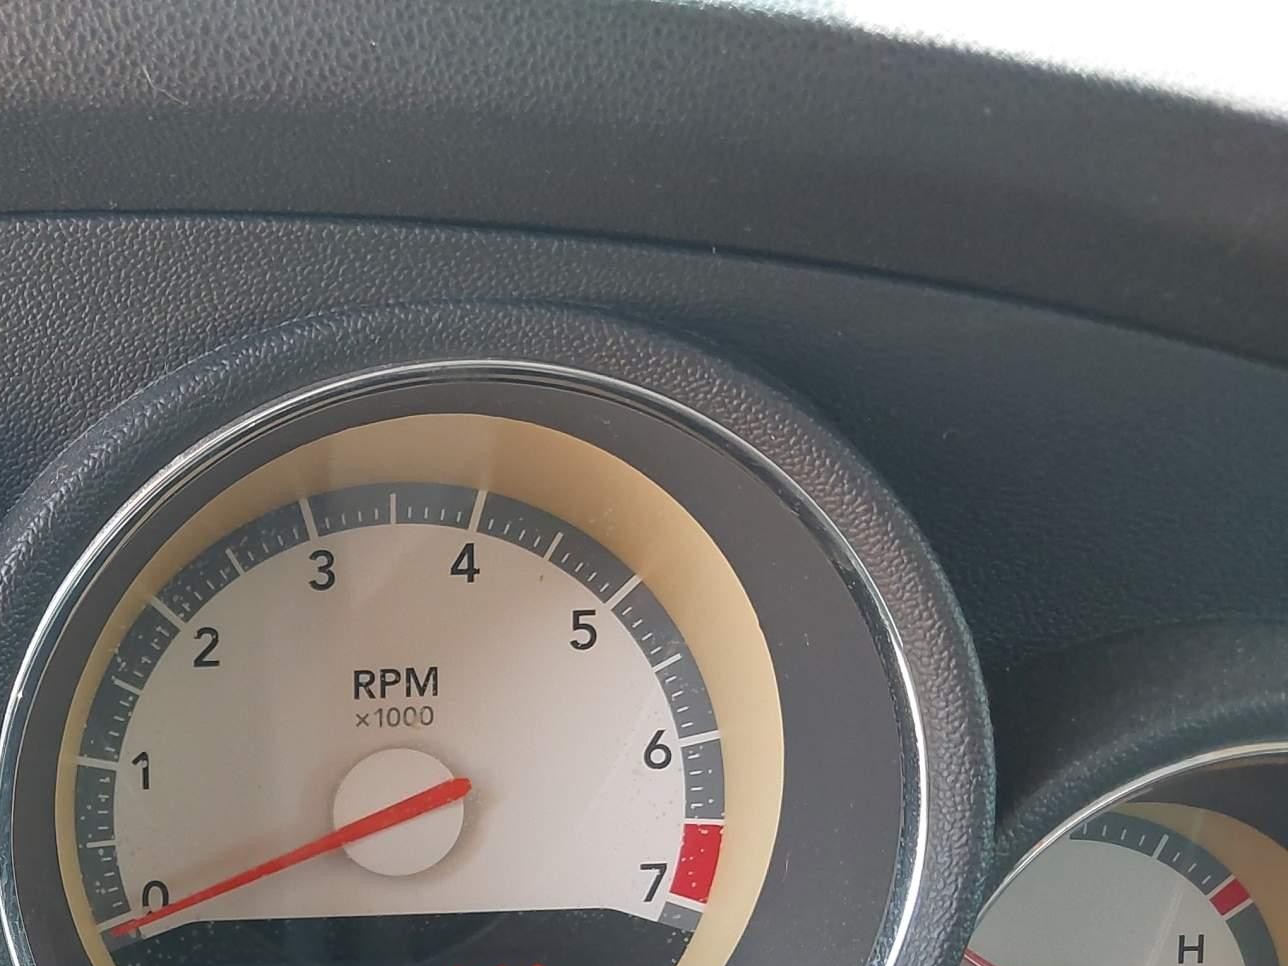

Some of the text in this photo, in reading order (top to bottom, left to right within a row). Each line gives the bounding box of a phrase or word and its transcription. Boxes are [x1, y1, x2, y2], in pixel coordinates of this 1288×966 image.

[309, 550, 336, 591] 3
[449, 543, 481, 584] 4
[192, 628, 221, 668] 2
[570, 610, 598, 650] 5
[353, 667, 440, 700] RPM
[643, 730, 673, 770] 6
[131, 752, 150, 790] 1
[142, 881, 169, 915] 0
[640, 864, 668, 903] 7
[1178, 934, 1205, 964] H
